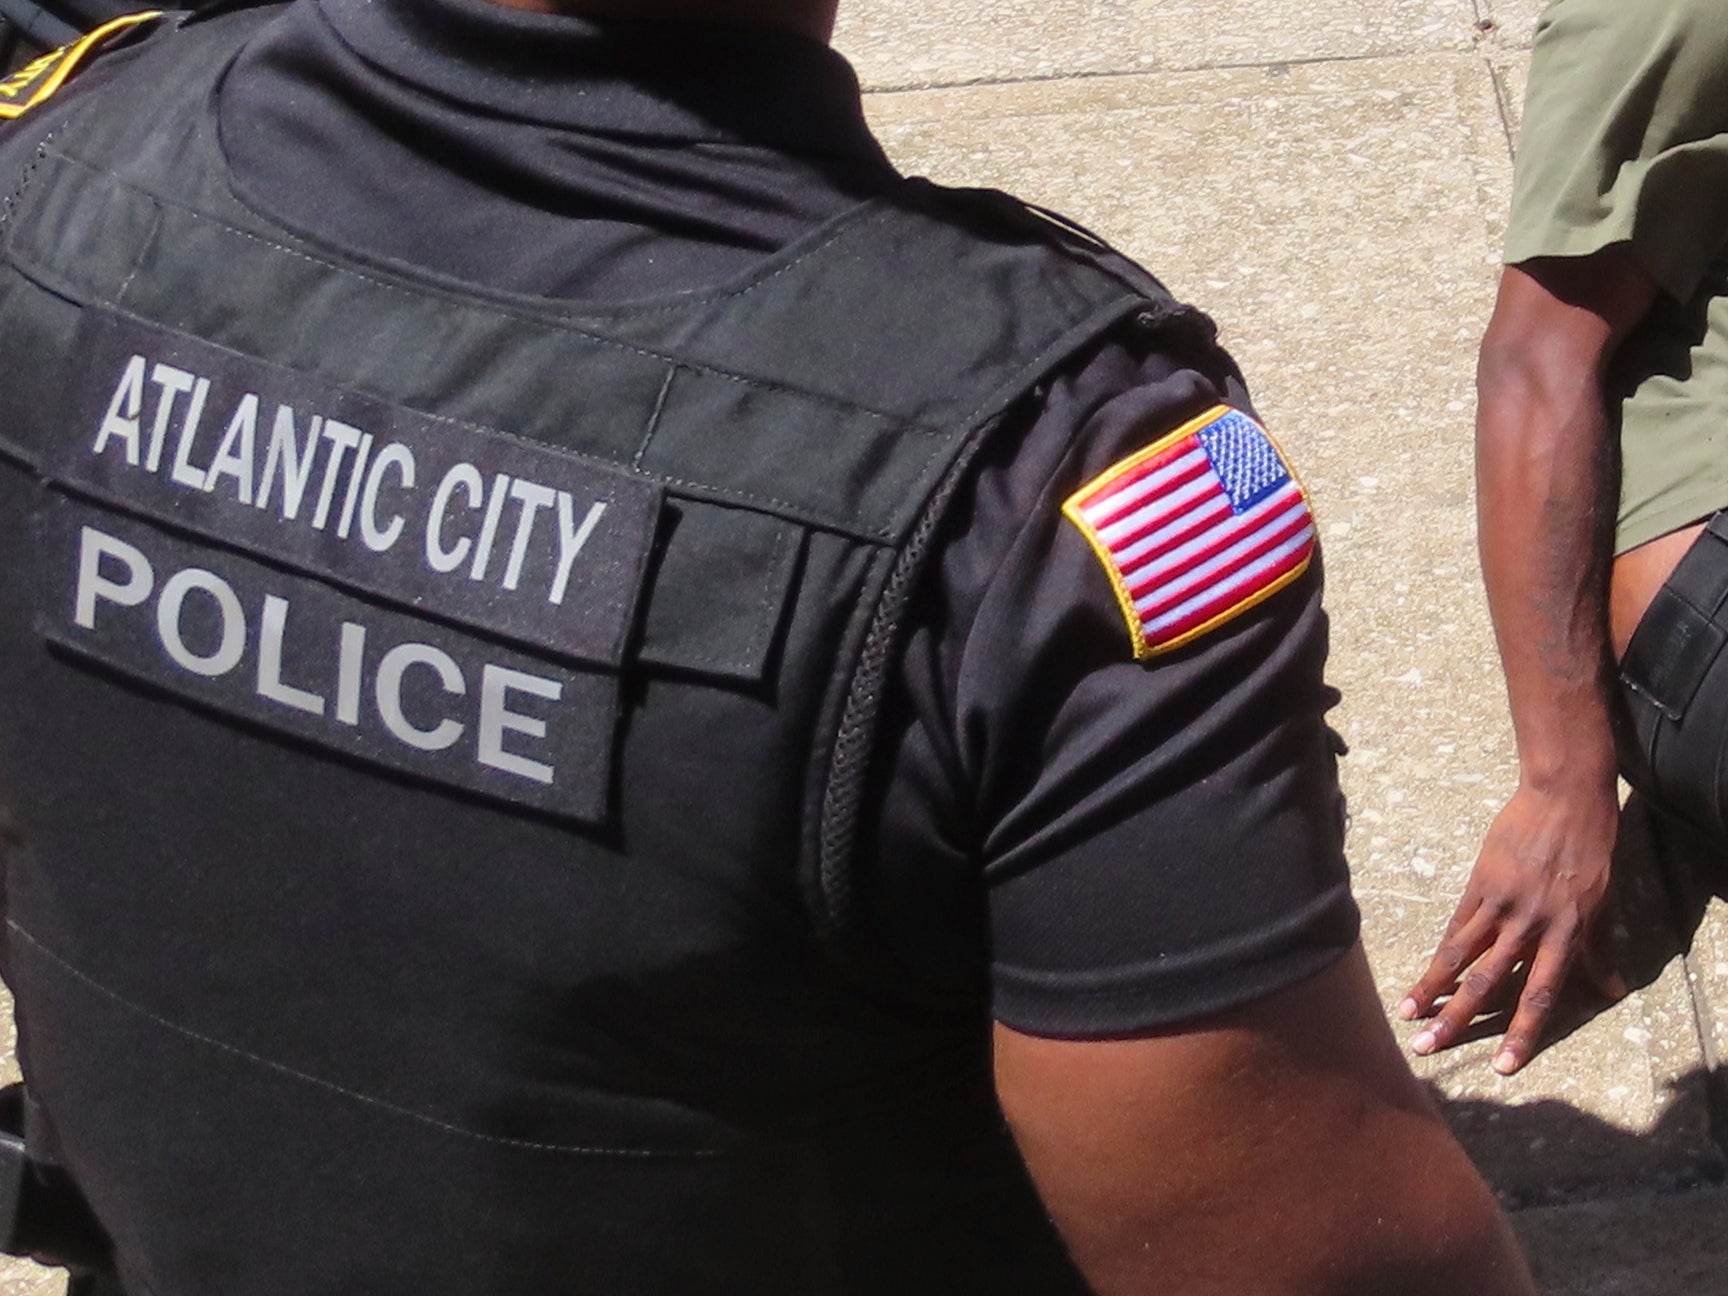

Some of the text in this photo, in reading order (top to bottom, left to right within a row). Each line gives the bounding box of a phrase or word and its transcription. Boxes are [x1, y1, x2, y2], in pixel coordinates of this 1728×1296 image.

[93, 354, 608, 606] ATLANTIC CITY
[73, 525, 564, 785] POLICE
